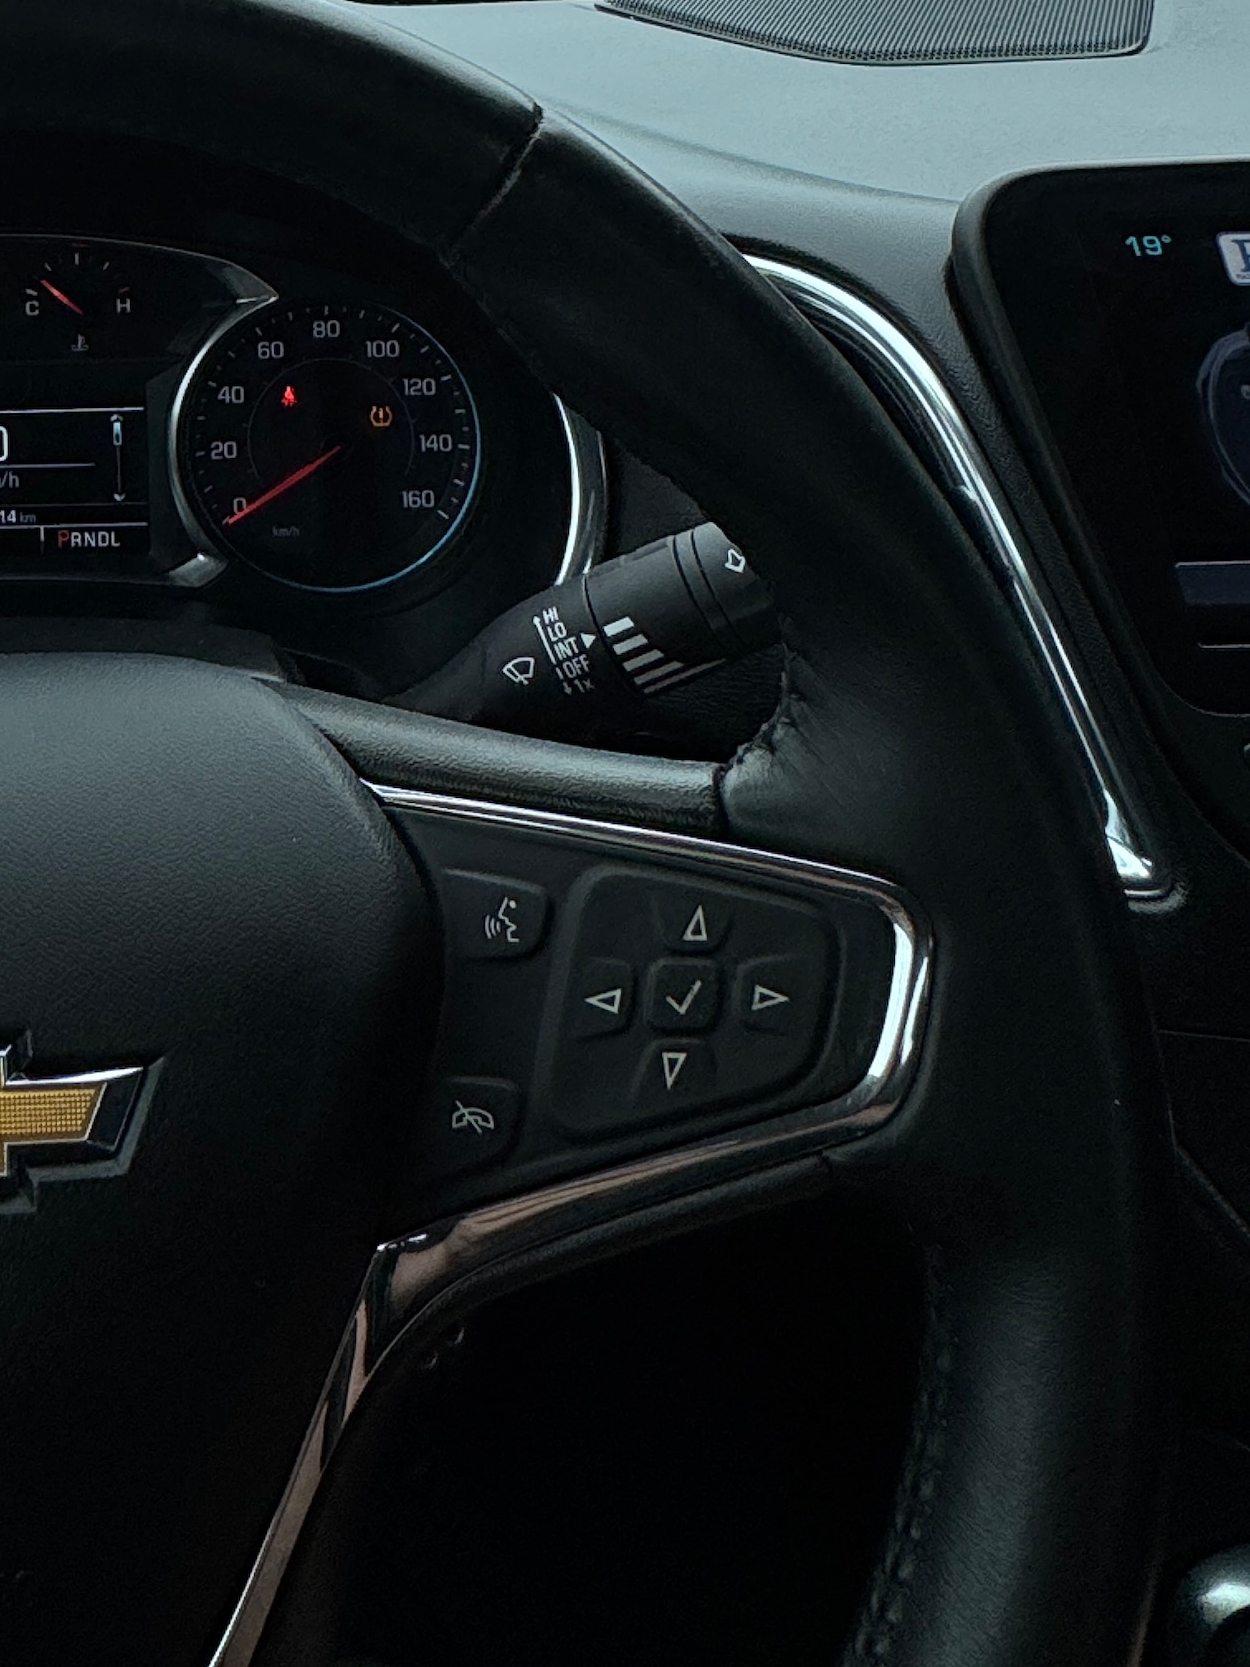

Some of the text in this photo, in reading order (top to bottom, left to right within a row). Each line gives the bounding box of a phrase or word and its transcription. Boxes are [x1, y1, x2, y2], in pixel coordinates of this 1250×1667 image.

[1125, 235, 1171, 256] 19°
[25, 302, 40, 317] C
[116, 299, 131, 314] H
[313, 320, 340, 338] 80
[258, 342, 284, 359] 60
[366, 340, 400, 358] 100
[218, 386, 245, 404] 40
[403, 378, 436, 396] 120
[211, 441, 237, 459] 20
[419, 434, 452, 452] 140
[402, 490, 434, 508] 160
[19, 512, 37, 524] km
[57, 531, 121, 548] PRNDL
[543, 606, 559, 623] HI
[547, 622, 568, 642] LO
[553, 637, 579, 659] INT
[562, 655, 590, 679] OFF
